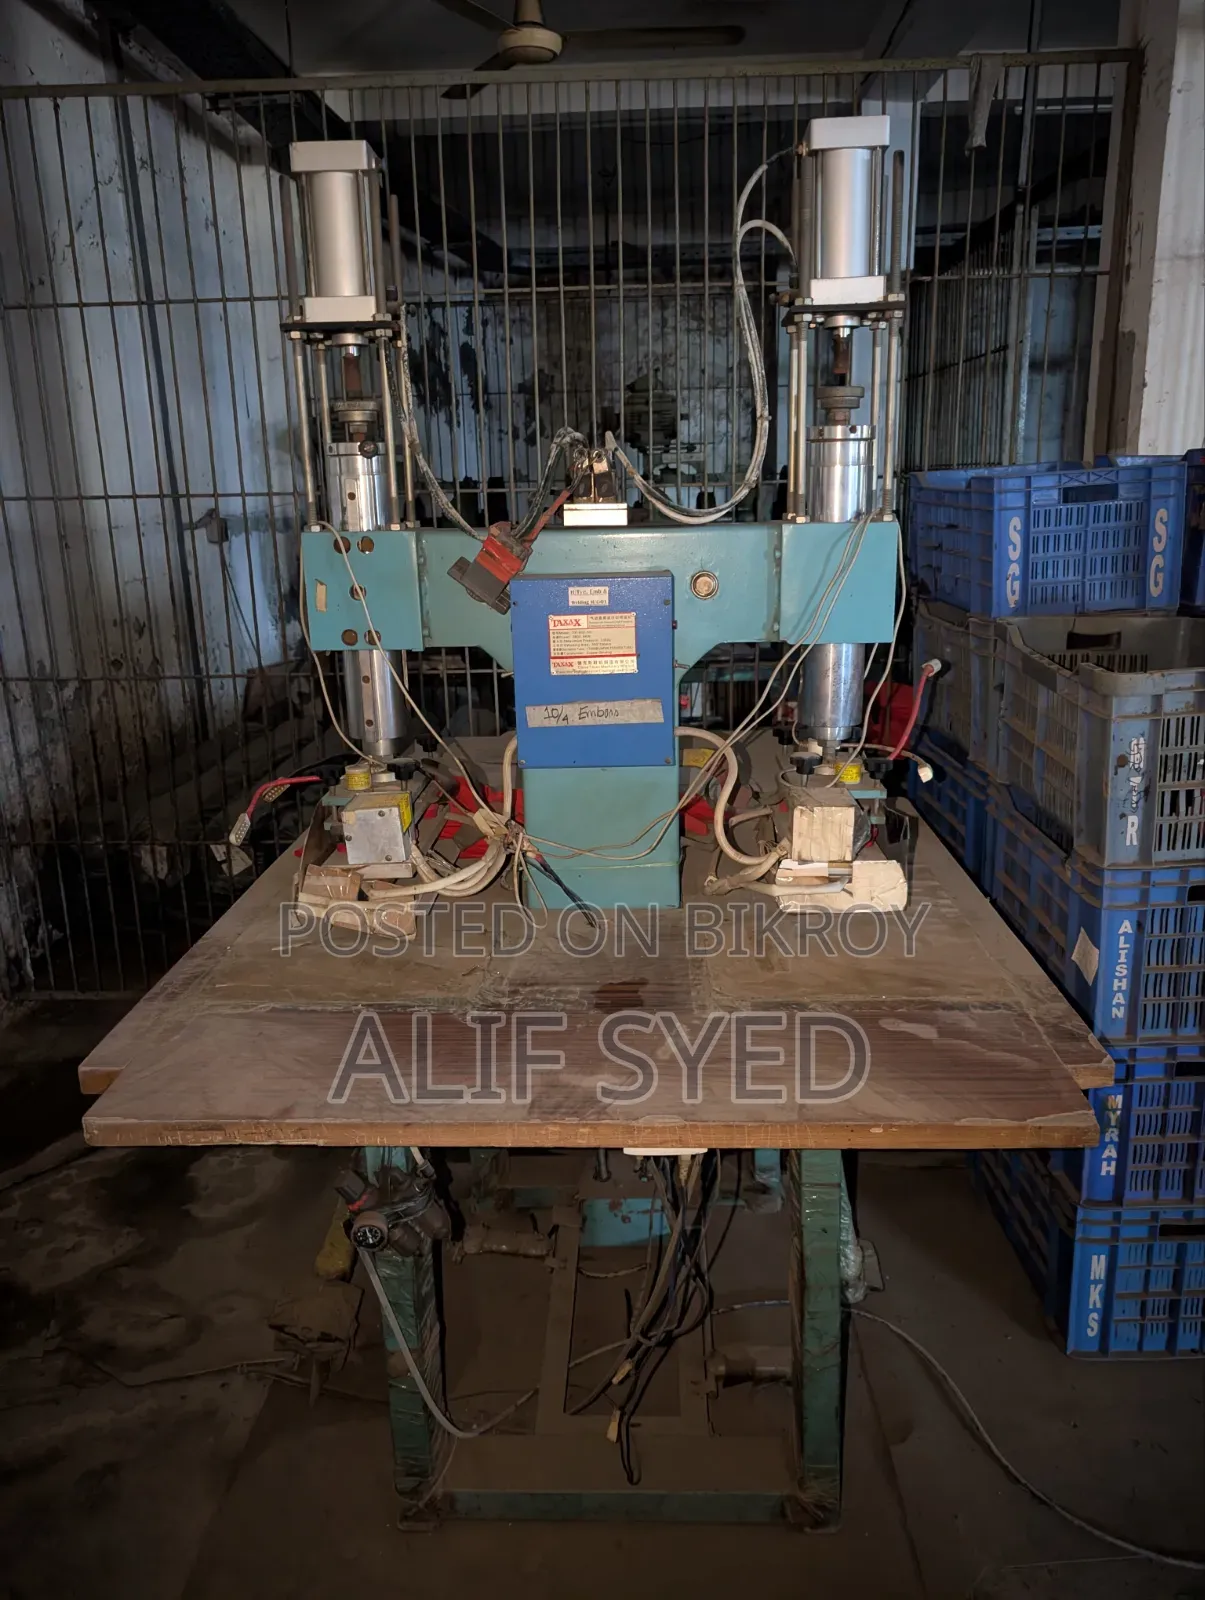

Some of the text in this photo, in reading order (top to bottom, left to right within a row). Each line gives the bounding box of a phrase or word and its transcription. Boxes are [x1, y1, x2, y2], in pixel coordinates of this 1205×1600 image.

[1149, 508, 1168, 598] SG
[1111, 919, 1134, 1019] ALISHAN
[1100, 1094, 1122, 1176] MYRAH
[1086, 1254, 1106, 1337] MKS
